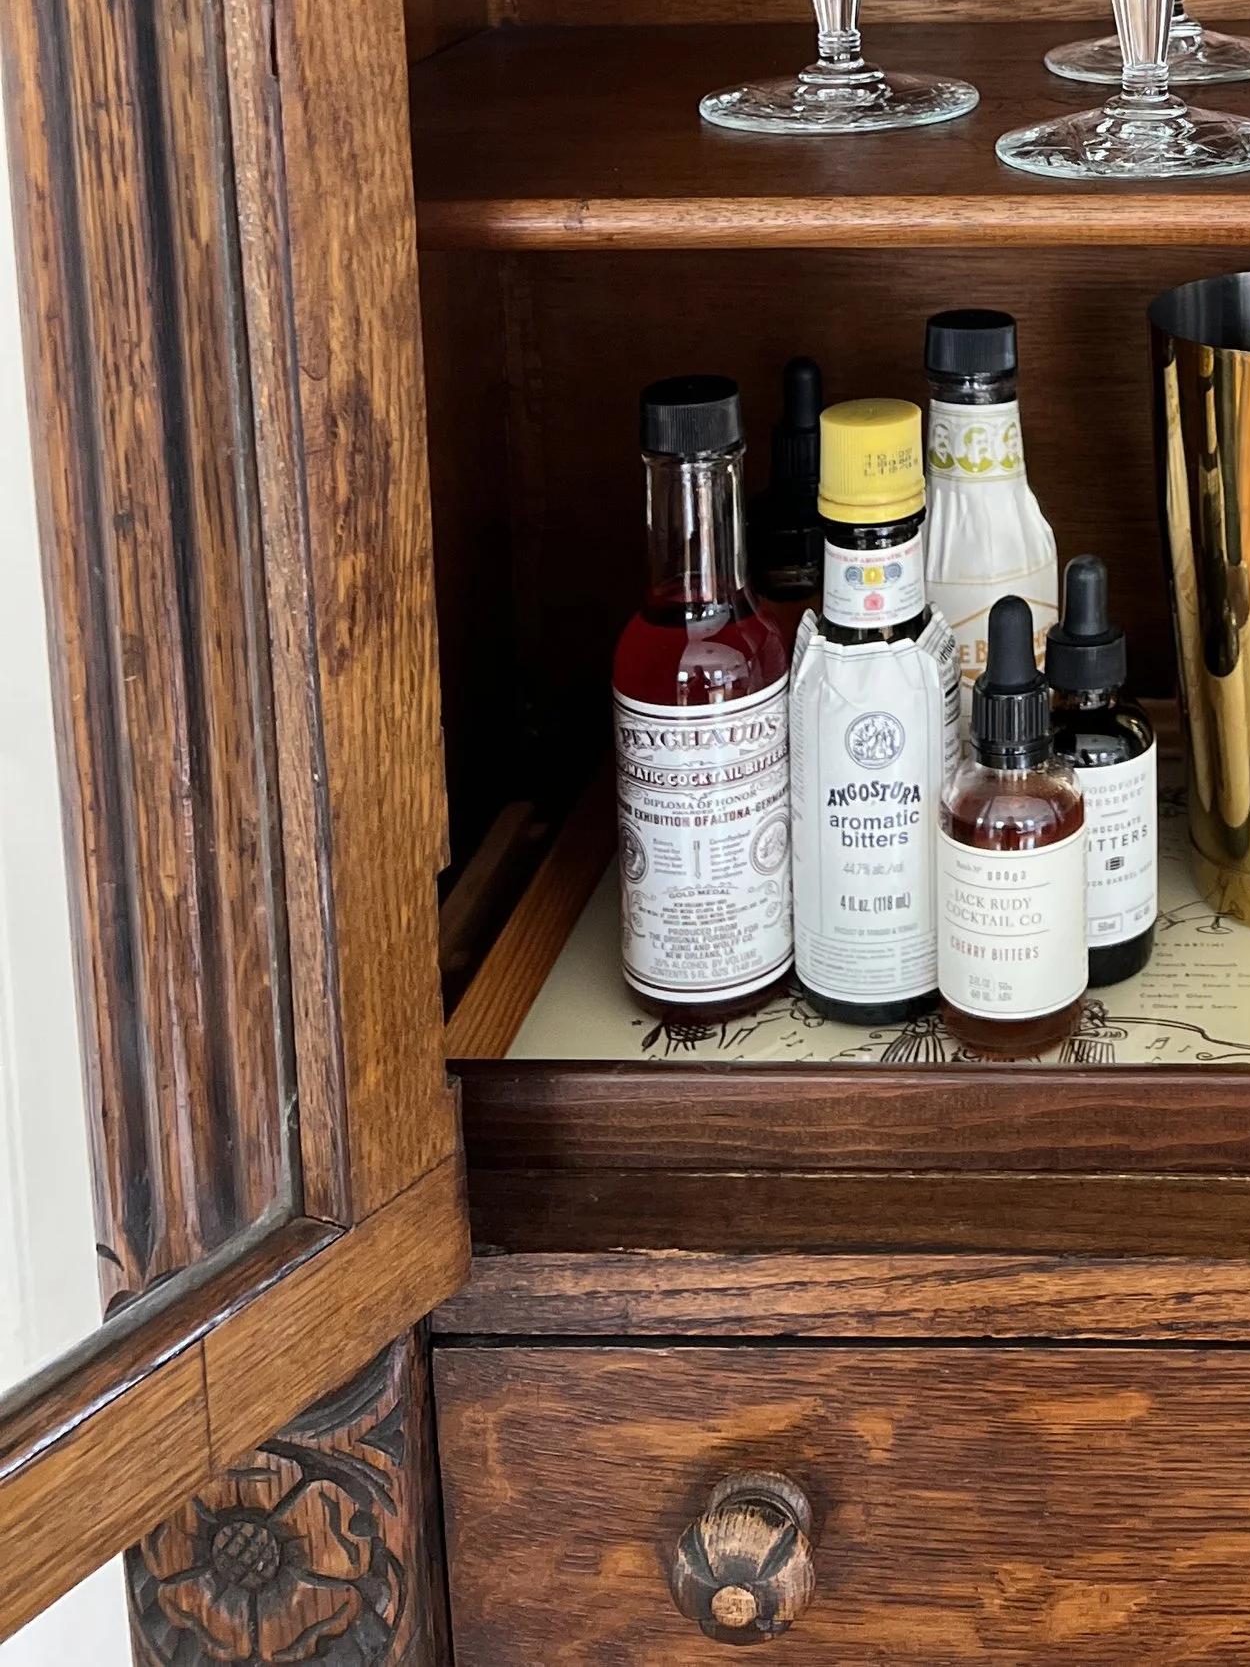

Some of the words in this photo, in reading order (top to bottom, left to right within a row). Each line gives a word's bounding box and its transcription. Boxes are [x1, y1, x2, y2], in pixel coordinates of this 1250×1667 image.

[667, 767, 743, 786] COCKTAIL
[745, 745, 789, 775] BITTERS
[643, 796, 694, 810] DIPLOMA
[697, 797, 713, 809] OF
[827, 780, 921, 807] ANGOSTURA
[634, 808, 690, 827] EXHIBITION
[694, 814, 710, 827] OF
[829, 809, 921, 830] aromatic
[841, 830, 909, 848] bitters
[1088, 824, 1149, 852] ITTERS
[668, 891, 695, 899] GOLD
[698, 888, 731, 897] MEDAL
[954, 889, 985, 909] JACK
[990, 897, 1032, 911] RUDY
[840, 894, 847, 911] 4
[873, 895, 894, 914] (118
[945, 899, 1014, 927] COCKTAIL
[664, 934, 700, 944] ORIGINAL
[668, 927, 712, 937] PRODUCED
[693, 942, 711, 952] AND
[950, 935, 986, 959] CHERRY
[991, 946, 1041, 962] BITTERS
